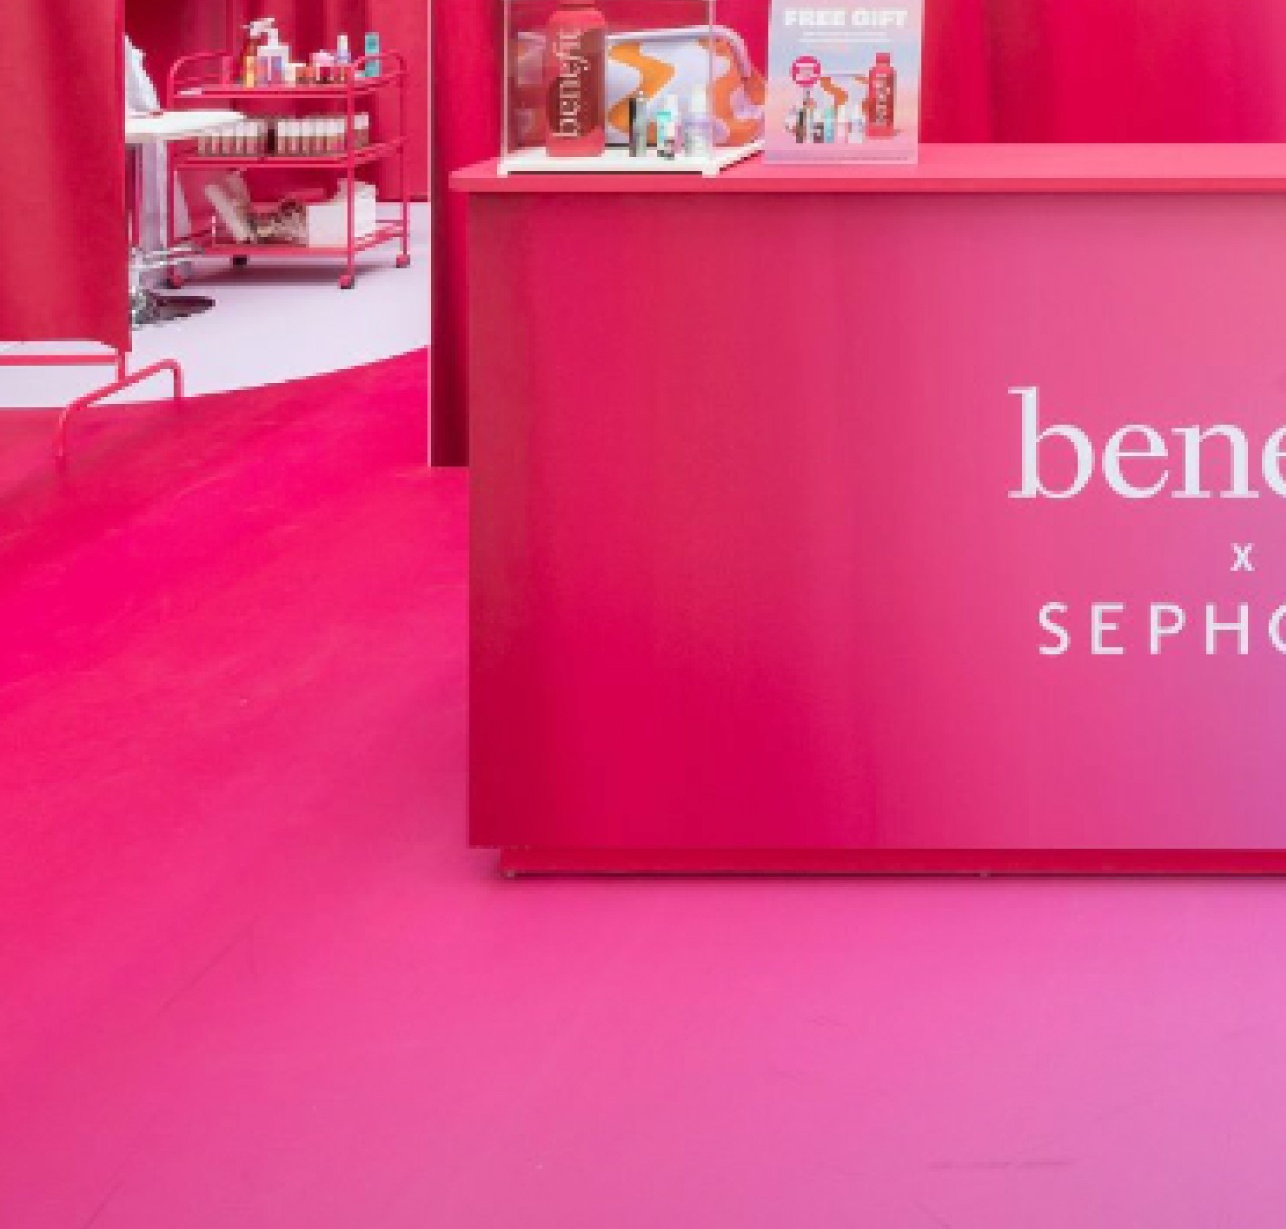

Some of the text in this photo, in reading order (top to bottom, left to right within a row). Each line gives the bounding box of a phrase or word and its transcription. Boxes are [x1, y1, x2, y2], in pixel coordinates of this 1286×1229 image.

[783, 8, 908, 27] FREE GIFT
[552, 27, 589, 137] benefit
[1230, 542, 1256, 572] x
